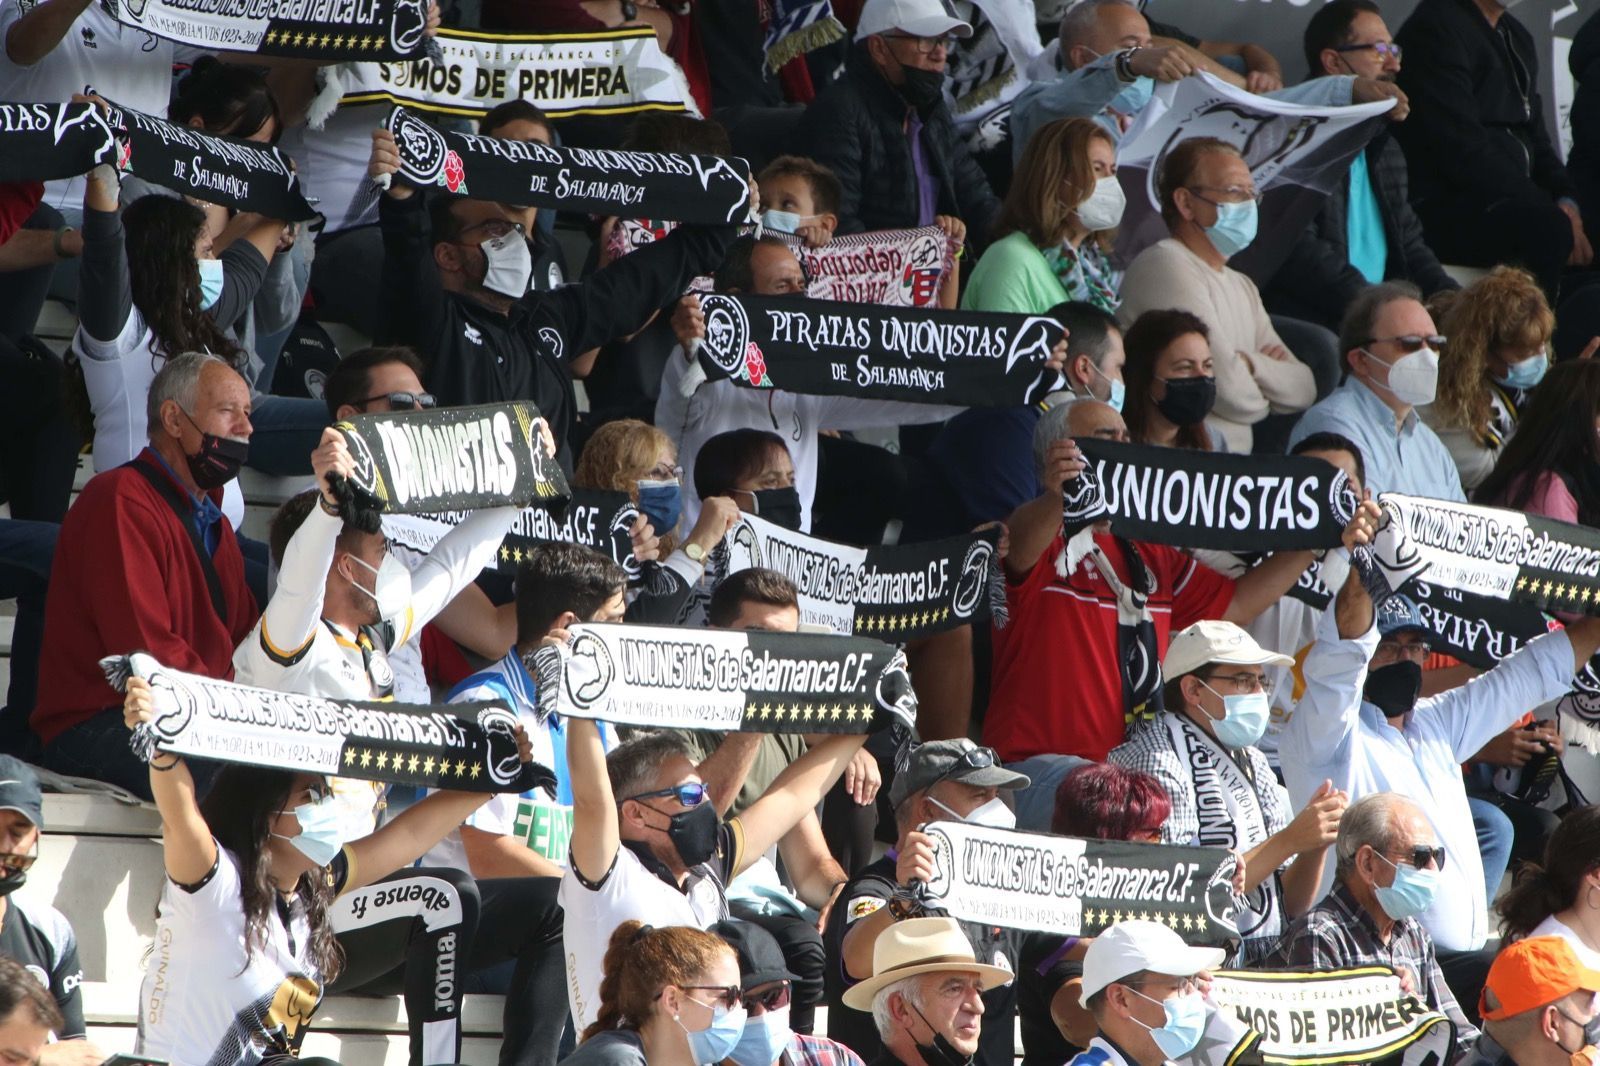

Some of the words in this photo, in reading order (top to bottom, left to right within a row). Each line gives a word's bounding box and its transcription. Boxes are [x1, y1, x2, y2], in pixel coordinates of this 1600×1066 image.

[160, 18, 203, 40] MEMORIAM
[510, 51, 594, 61] SALAMANCA
[474, 68, 506, 98] DE
[450, 130, 563, 165] PIRATAS
[568, 147, 693, 177] UNIONISTAS
[765, 309, 872, 352] PIRATAS
[880, 316, 1007, 361] UNIONISTAS
[375, 411, 517, 505] UNIONISTAS
[1097, 459, 1320, 531] UNIONISTAS
[1408, 502, 1500, 560] UNIONISTAS
[1495, 525, 1521, 565] de
[1516, 526, 1600, 578] Salamanca
[834, 563, 855, 606] de
[852, 563, 926, 605] Salamanca
[926, 557, 950, 602] C.F.
[619, 637, 717, 692] UNIONISTAS
[716, 650, 740, 694] de
[739, 646, 840, 695] Salamanca
[839, 652, 874, 693] C.F.
[199, 682, 311, 734] UNIONISTAS
[309, 697, 337, 739] de
[335, 698, 442, 747] Salamanca
[440, 712, 477, 750] C.F.
[962, 837, 1052, 897] UNIONISTAS
[1053, 853, 1078, 898] de
[1075, 855, 1168, 903] Salamanca
[1165, 862, 1200, 904] C.F.
[148, 927, 173, 1025] GUINALDO
[434, 931, 457, 1013] joma
[1289, 1010, 1317, 1044] DE
